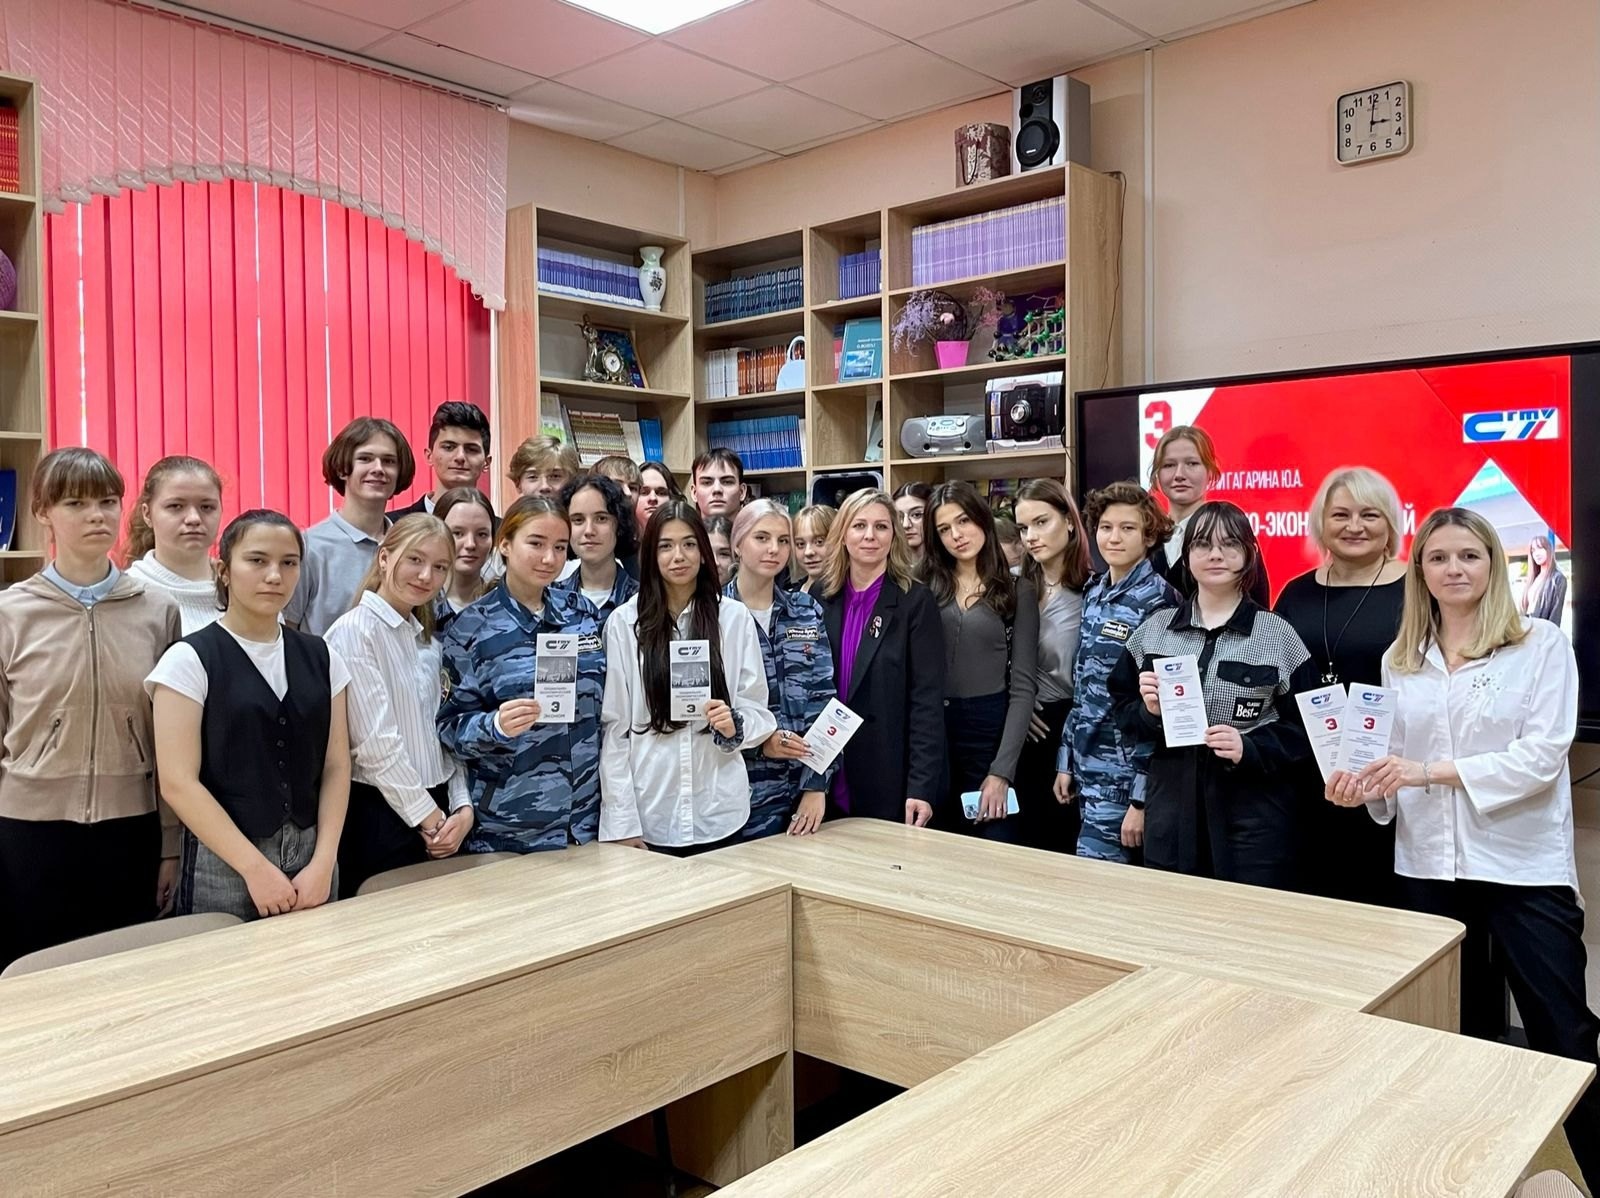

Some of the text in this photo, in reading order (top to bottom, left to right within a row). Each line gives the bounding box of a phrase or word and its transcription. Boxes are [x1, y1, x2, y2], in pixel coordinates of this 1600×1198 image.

[1367, 93, 1379, 104] 12
[1385, 90, 1389, 100] 1
[1353, 97, 1362, 108] 11
[1395, 96, 1402, 107] 2
[1343, 107, 1355, 118] 10
[1395, 111, 1402, 122] 3
[1345, 123, 1351, 133] 9
[1395, 126, 1402, 136] 4
[1345, 138, 1351, 148] 8
[1370, 142, 1377, 151] 6
[1385, 138, 1392, 148] 5
[1356, 144, 1363, 155] 7
[1227, 470, 1279, 490] ГАГАРИНА
[1281, 469, 1304, 488] Ю.А.
[1248, 503, 1415, 537] О-ЭКОН Й
